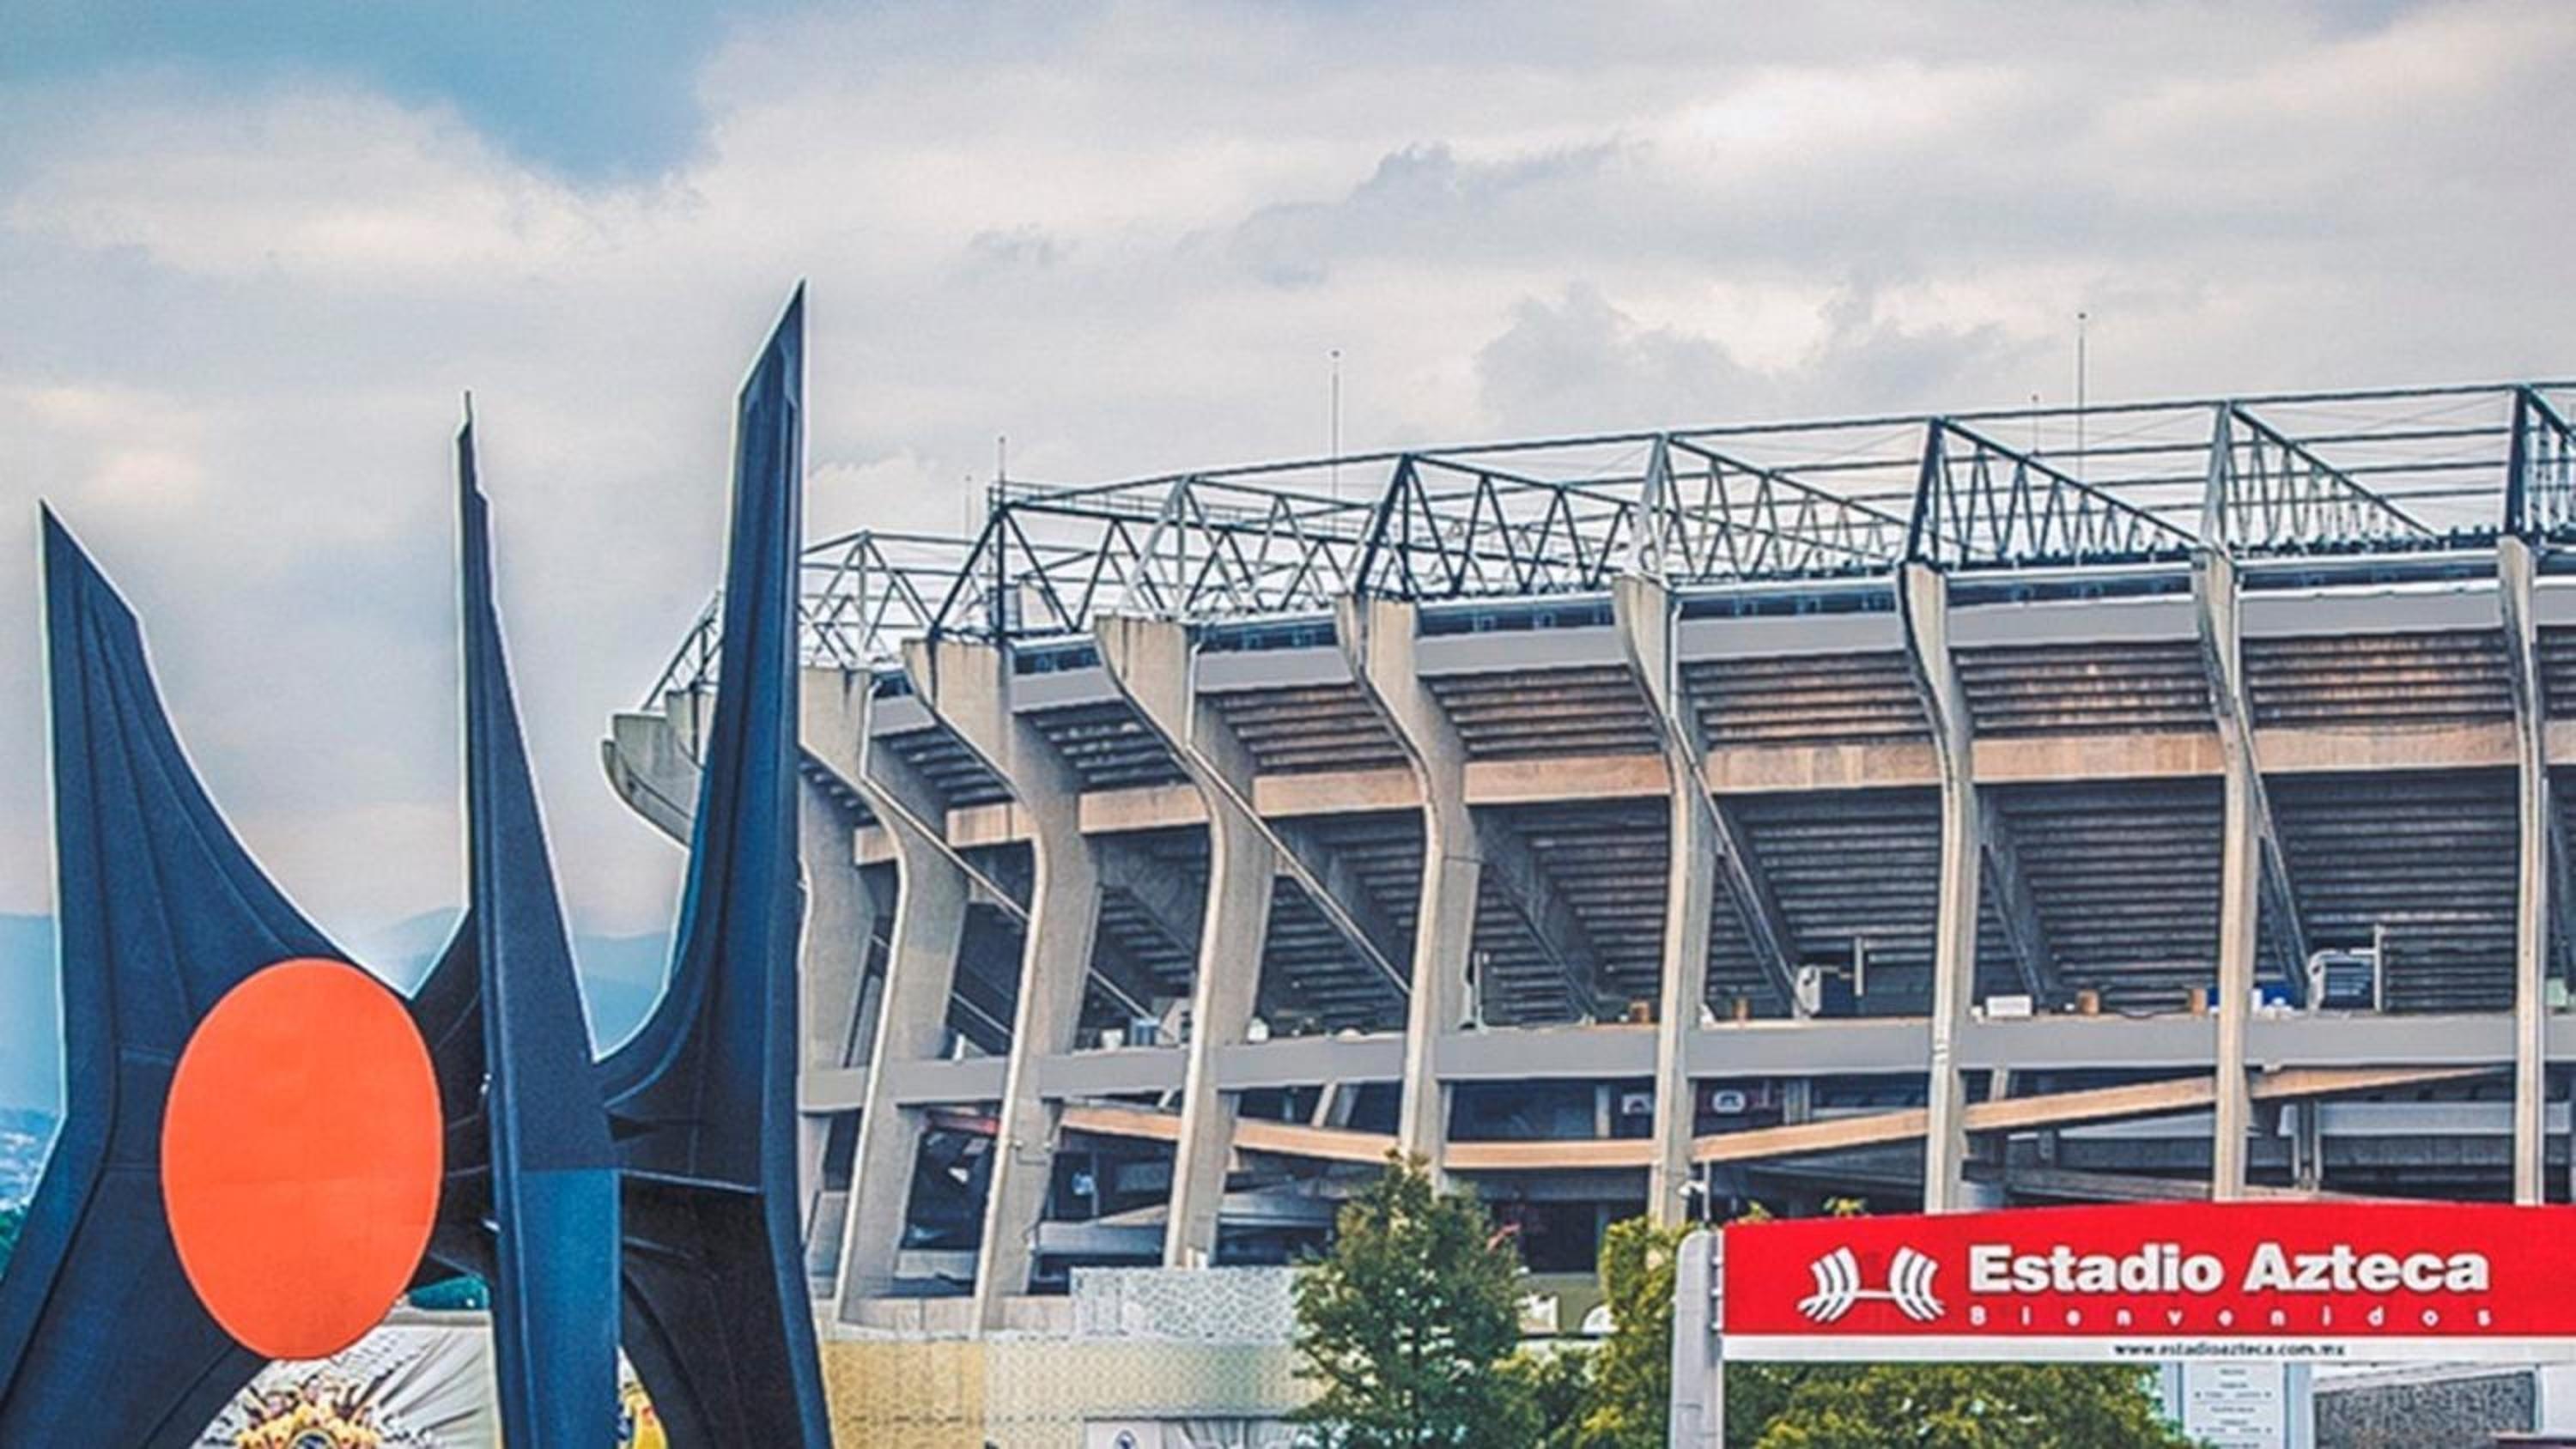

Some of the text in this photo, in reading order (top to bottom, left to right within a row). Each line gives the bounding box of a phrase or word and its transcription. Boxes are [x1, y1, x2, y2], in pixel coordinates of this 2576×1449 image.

[1969, 1242, 2489, 1293] Estadio Azteca
[1970, 1305, 2491, 1326] Bienvenidos
[2113, 1342, 2348, 1357] www.estadioazteca.com.mx
